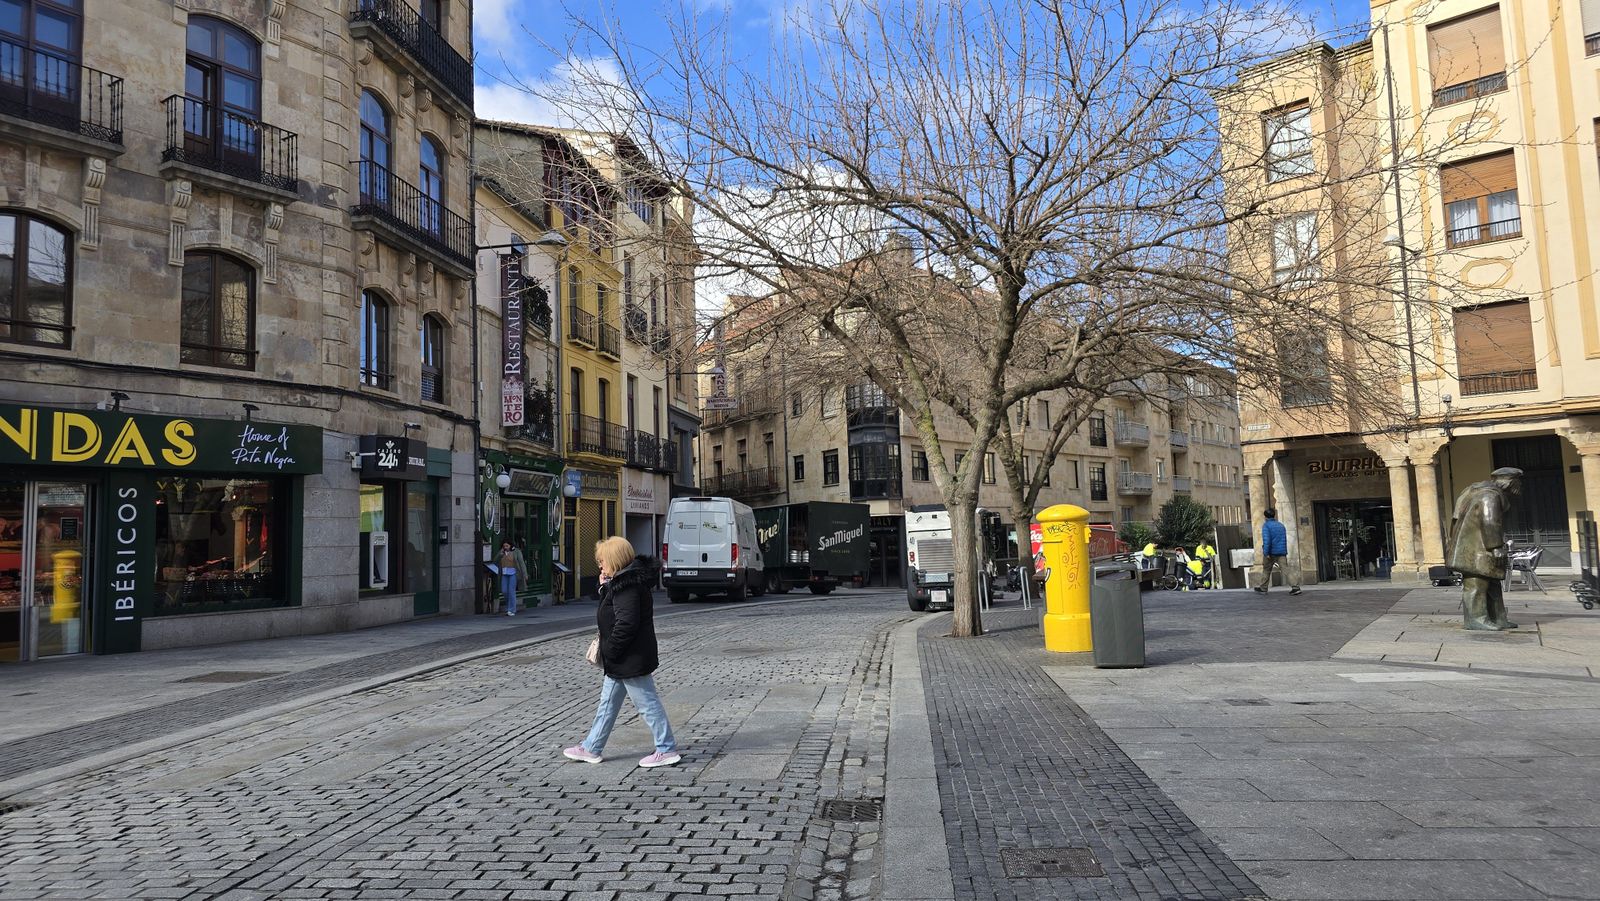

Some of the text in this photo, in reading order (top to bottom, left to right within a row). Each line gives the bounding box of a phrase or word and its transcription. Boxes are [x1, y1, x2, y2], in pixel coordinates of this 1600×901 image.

[504, 256, 521, 375] RESTAURANTE
[0, 408, 197, 467] NDAS
[238, 424, 289, 450] Home of
[232, 448, 296, 470] Pata Negra
[378, 452, 399, 469] 24h
[1307, 457, 1386, 473] BUITRAG
[111, 487, 138, 621] IBÉRICOS
